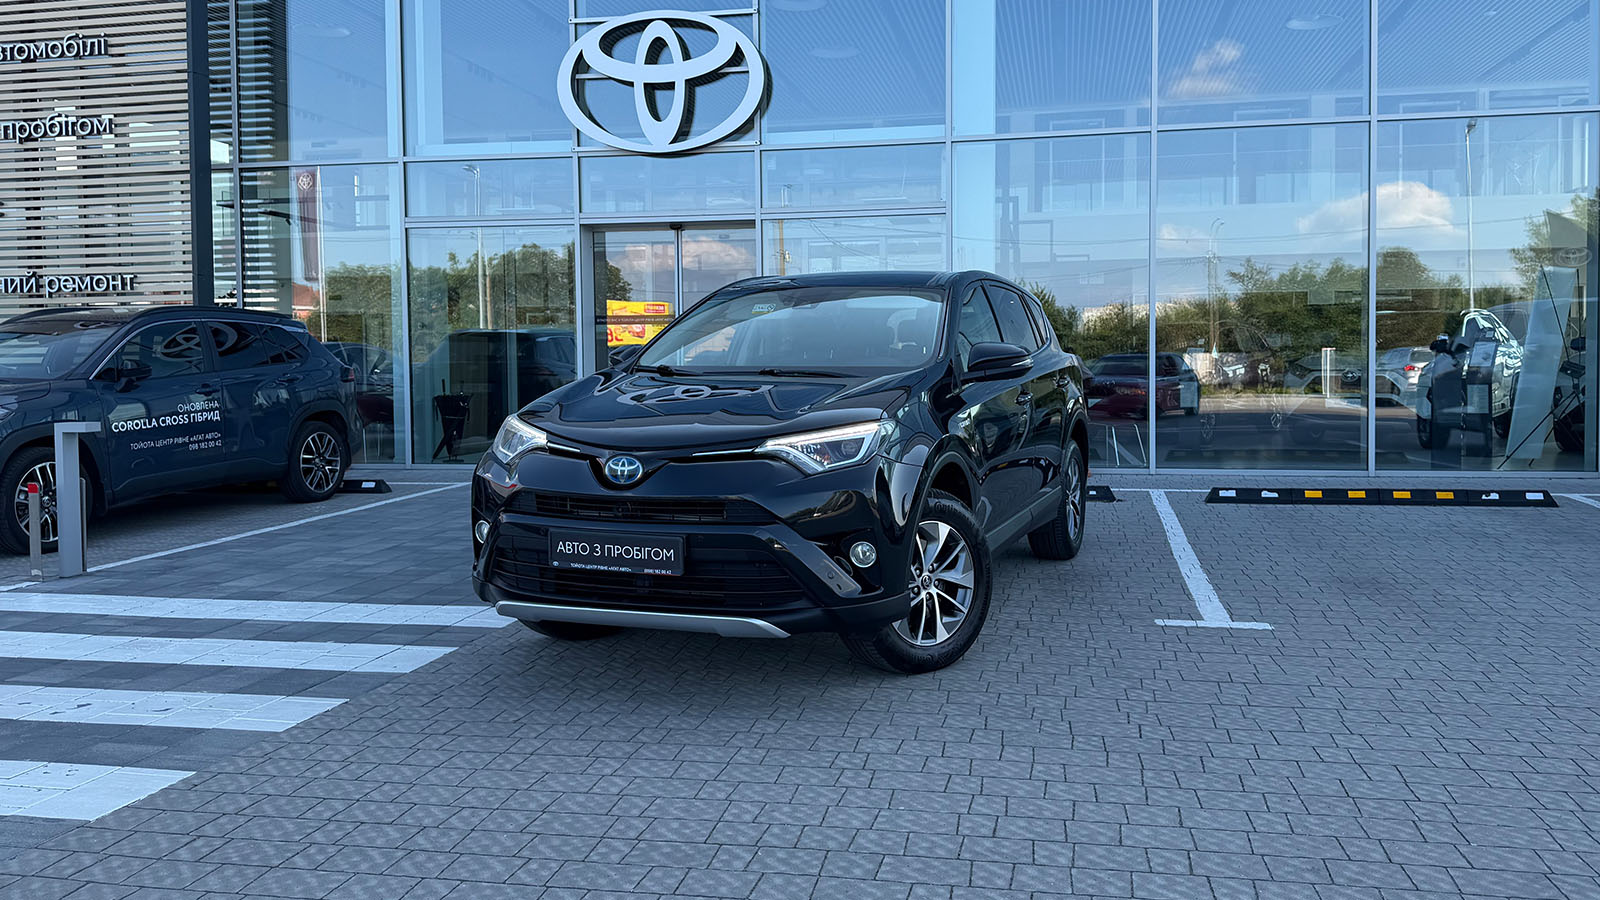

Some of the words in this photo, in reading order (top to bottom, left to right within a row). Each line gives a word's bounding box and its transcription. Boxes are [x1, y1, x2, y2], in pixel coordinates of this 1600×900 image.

[0, 32, 106, 60] томобілі
[1, 112, 111, 144] пробігом
[45, 274, 135, 299] ремонт
[177, 400, 220, 412] ОНОВЛЕНА
[111, 418, 158, 433] COROLLA
[159, 414, 189, 426] CROSS
[190, 410, 221, 423] ГІБРИД
[130, 441, 155, 450] ТОЙОТА
[155, 438, 174, 448] ЦЕНТР
[556, 541, 590, 556] АВТО
[593, 543, 602, 557] З
[604, 544, 674, 562] ПРОБІГОМ
